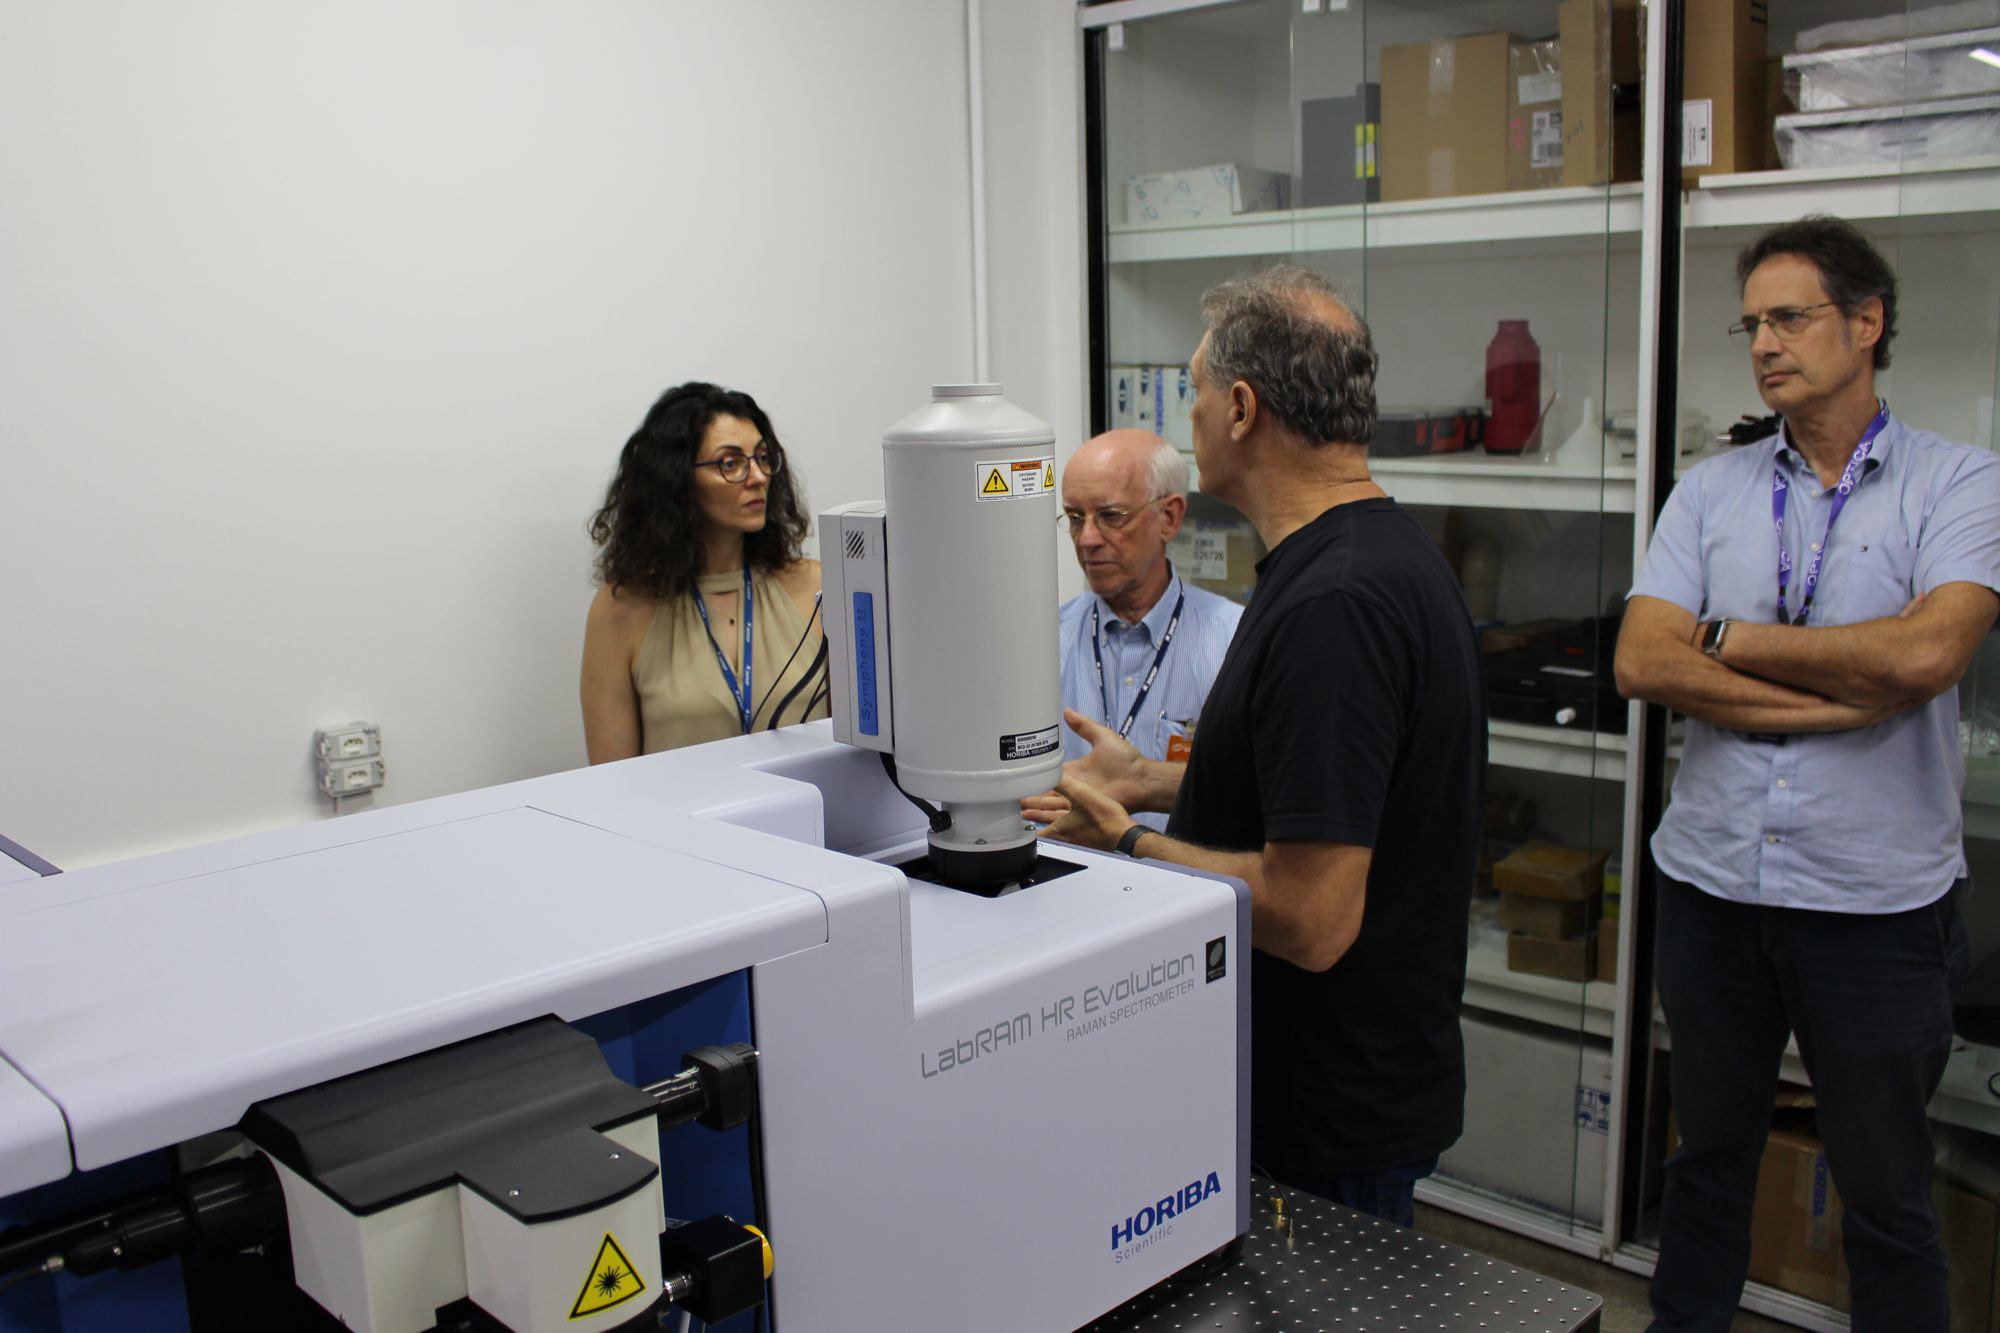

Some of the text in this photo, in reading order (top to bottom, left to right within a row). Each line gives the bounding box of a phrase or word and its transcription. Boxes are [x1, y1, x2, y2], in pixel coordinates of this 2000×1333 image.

[858, 627, 873, 721] Symphony
[921, 953, 1195, 1079] LabRAM HR Evolution
[1066, 978, 1194, 1042] RAMAN SPECTROMETER
[1111, 1170, 1221, 1251] HORIBA
[1115, 1225, 1174, 1264] Scientific
